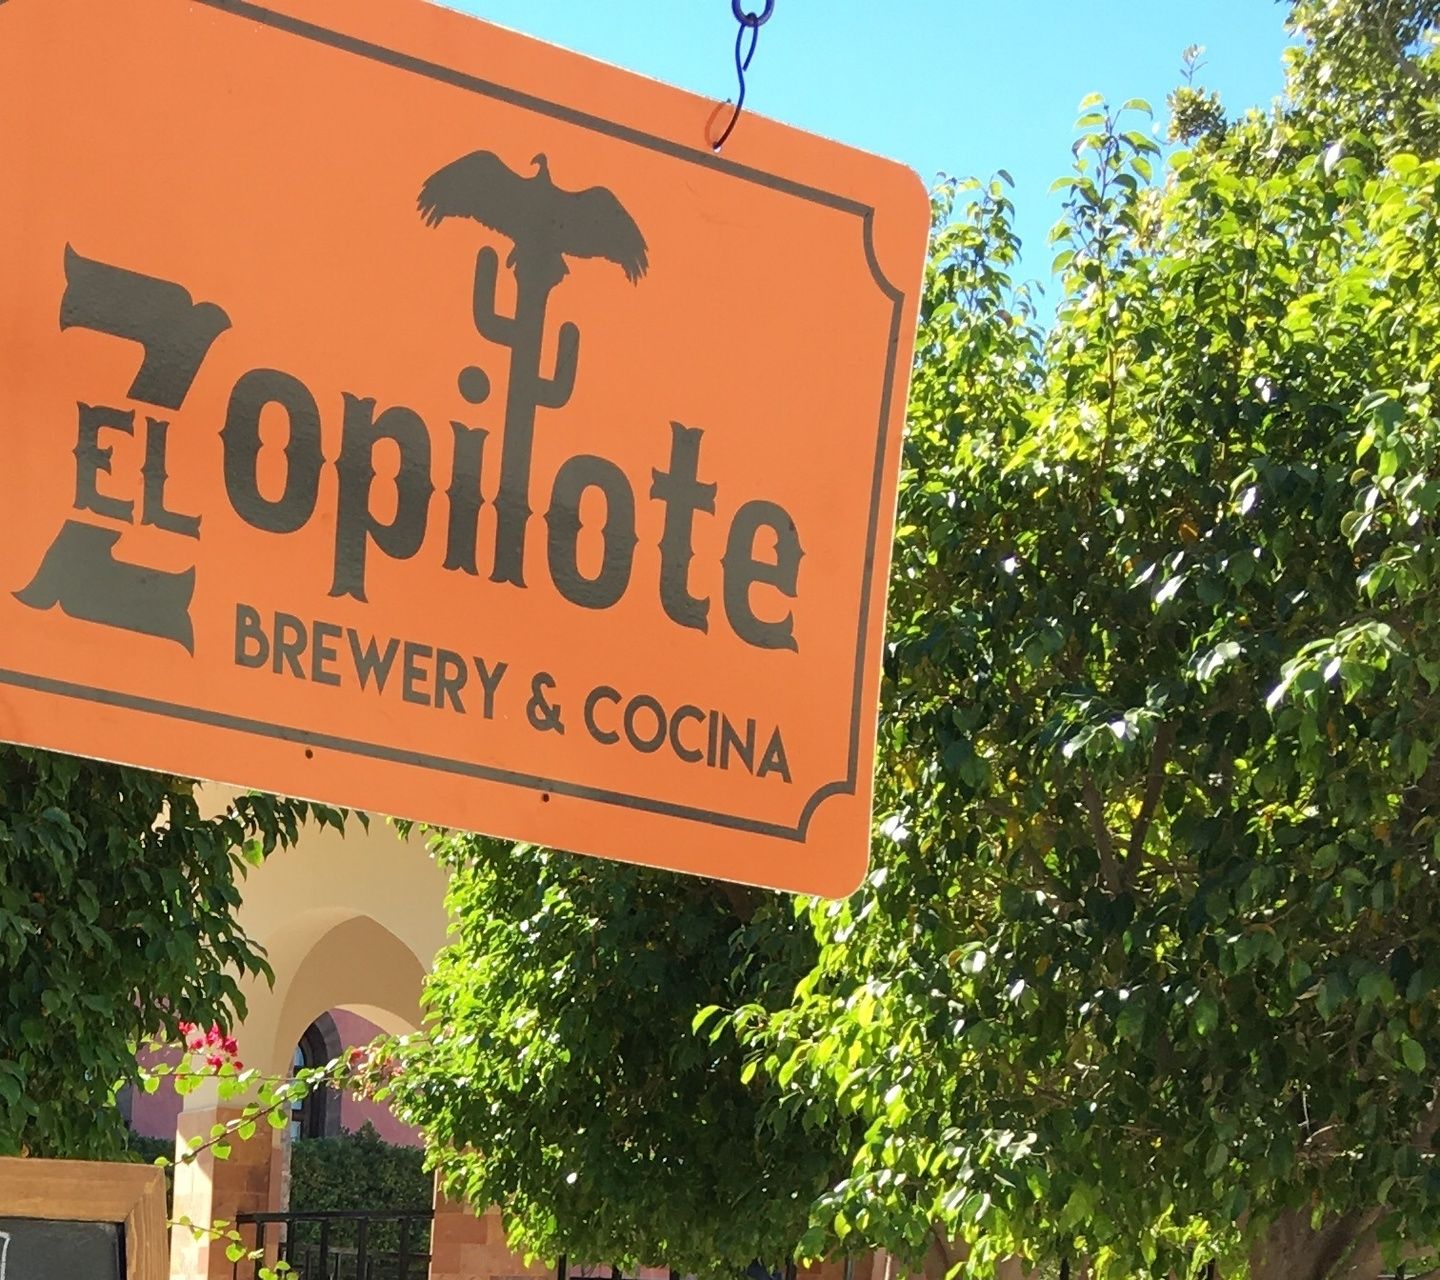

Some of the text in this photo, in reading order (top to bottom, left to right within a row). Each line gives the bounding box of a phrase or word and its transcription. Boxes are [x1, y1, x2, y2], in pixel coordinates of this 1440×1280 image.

[11, 242, 806, 656] EL Zopilote
[234, 602, 792, 784] BREWERY & COCINA
